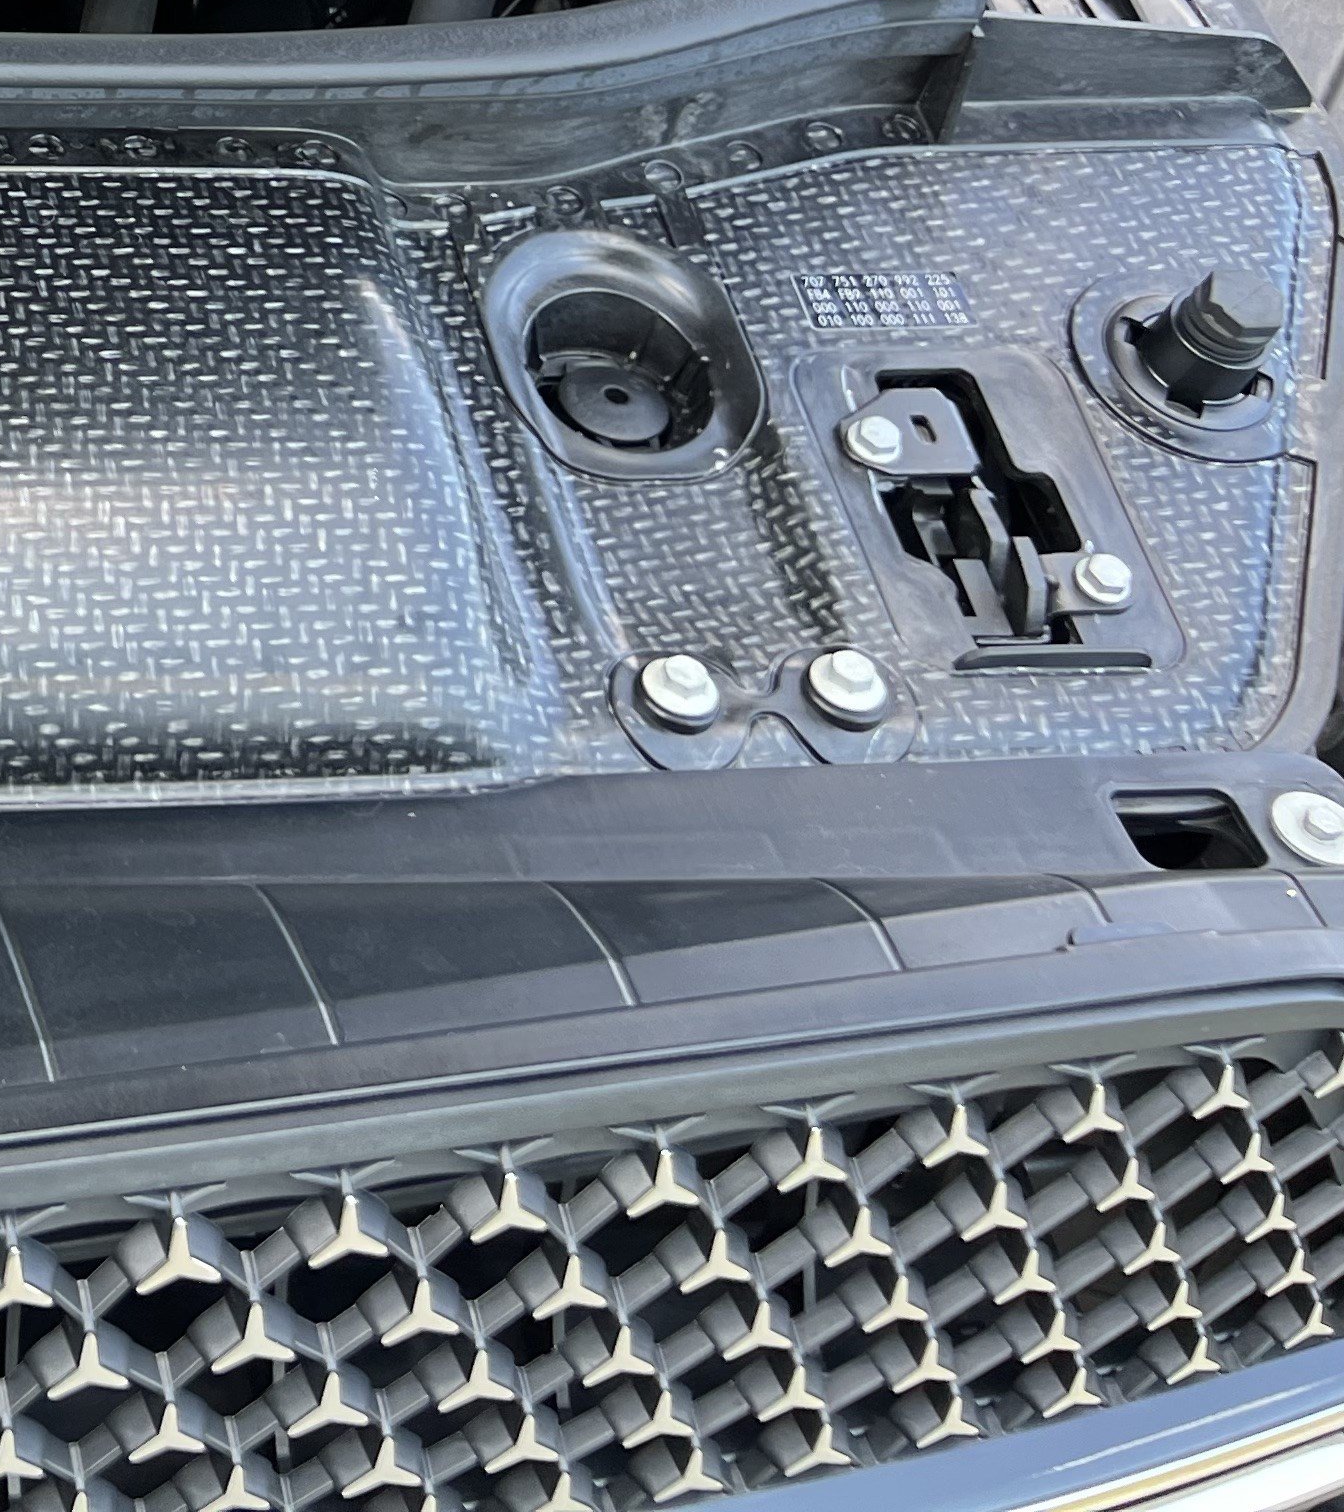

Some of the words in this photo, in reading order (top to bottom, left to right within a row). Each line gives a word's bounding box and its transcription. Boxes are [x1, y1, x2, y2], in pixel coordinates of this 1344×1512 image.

[801, 275, 825, 288] 707
[831, 275, 857, 288] 751
[863, 275, 888, 288] 270
[893, 274, 919, 287] 992
[924, 274, 950, 286] 225
[870, 288, 895, 300] 110
[899, 287, 925, 299] 001
[932, 287, 957, 299] 101
[812, 302, 838, 314] 000
[845, 301, 869, 313] 110
[874, 301, 900, 313] 000
[907, 300, 931, 312] 110
[936, 300, 961, 312] 001
[817, 314, 843, 327] 010
[850, 314, 874, 326] 100
[880, 314, 905, 326] 000
[913, 313, 936, 325] 111
